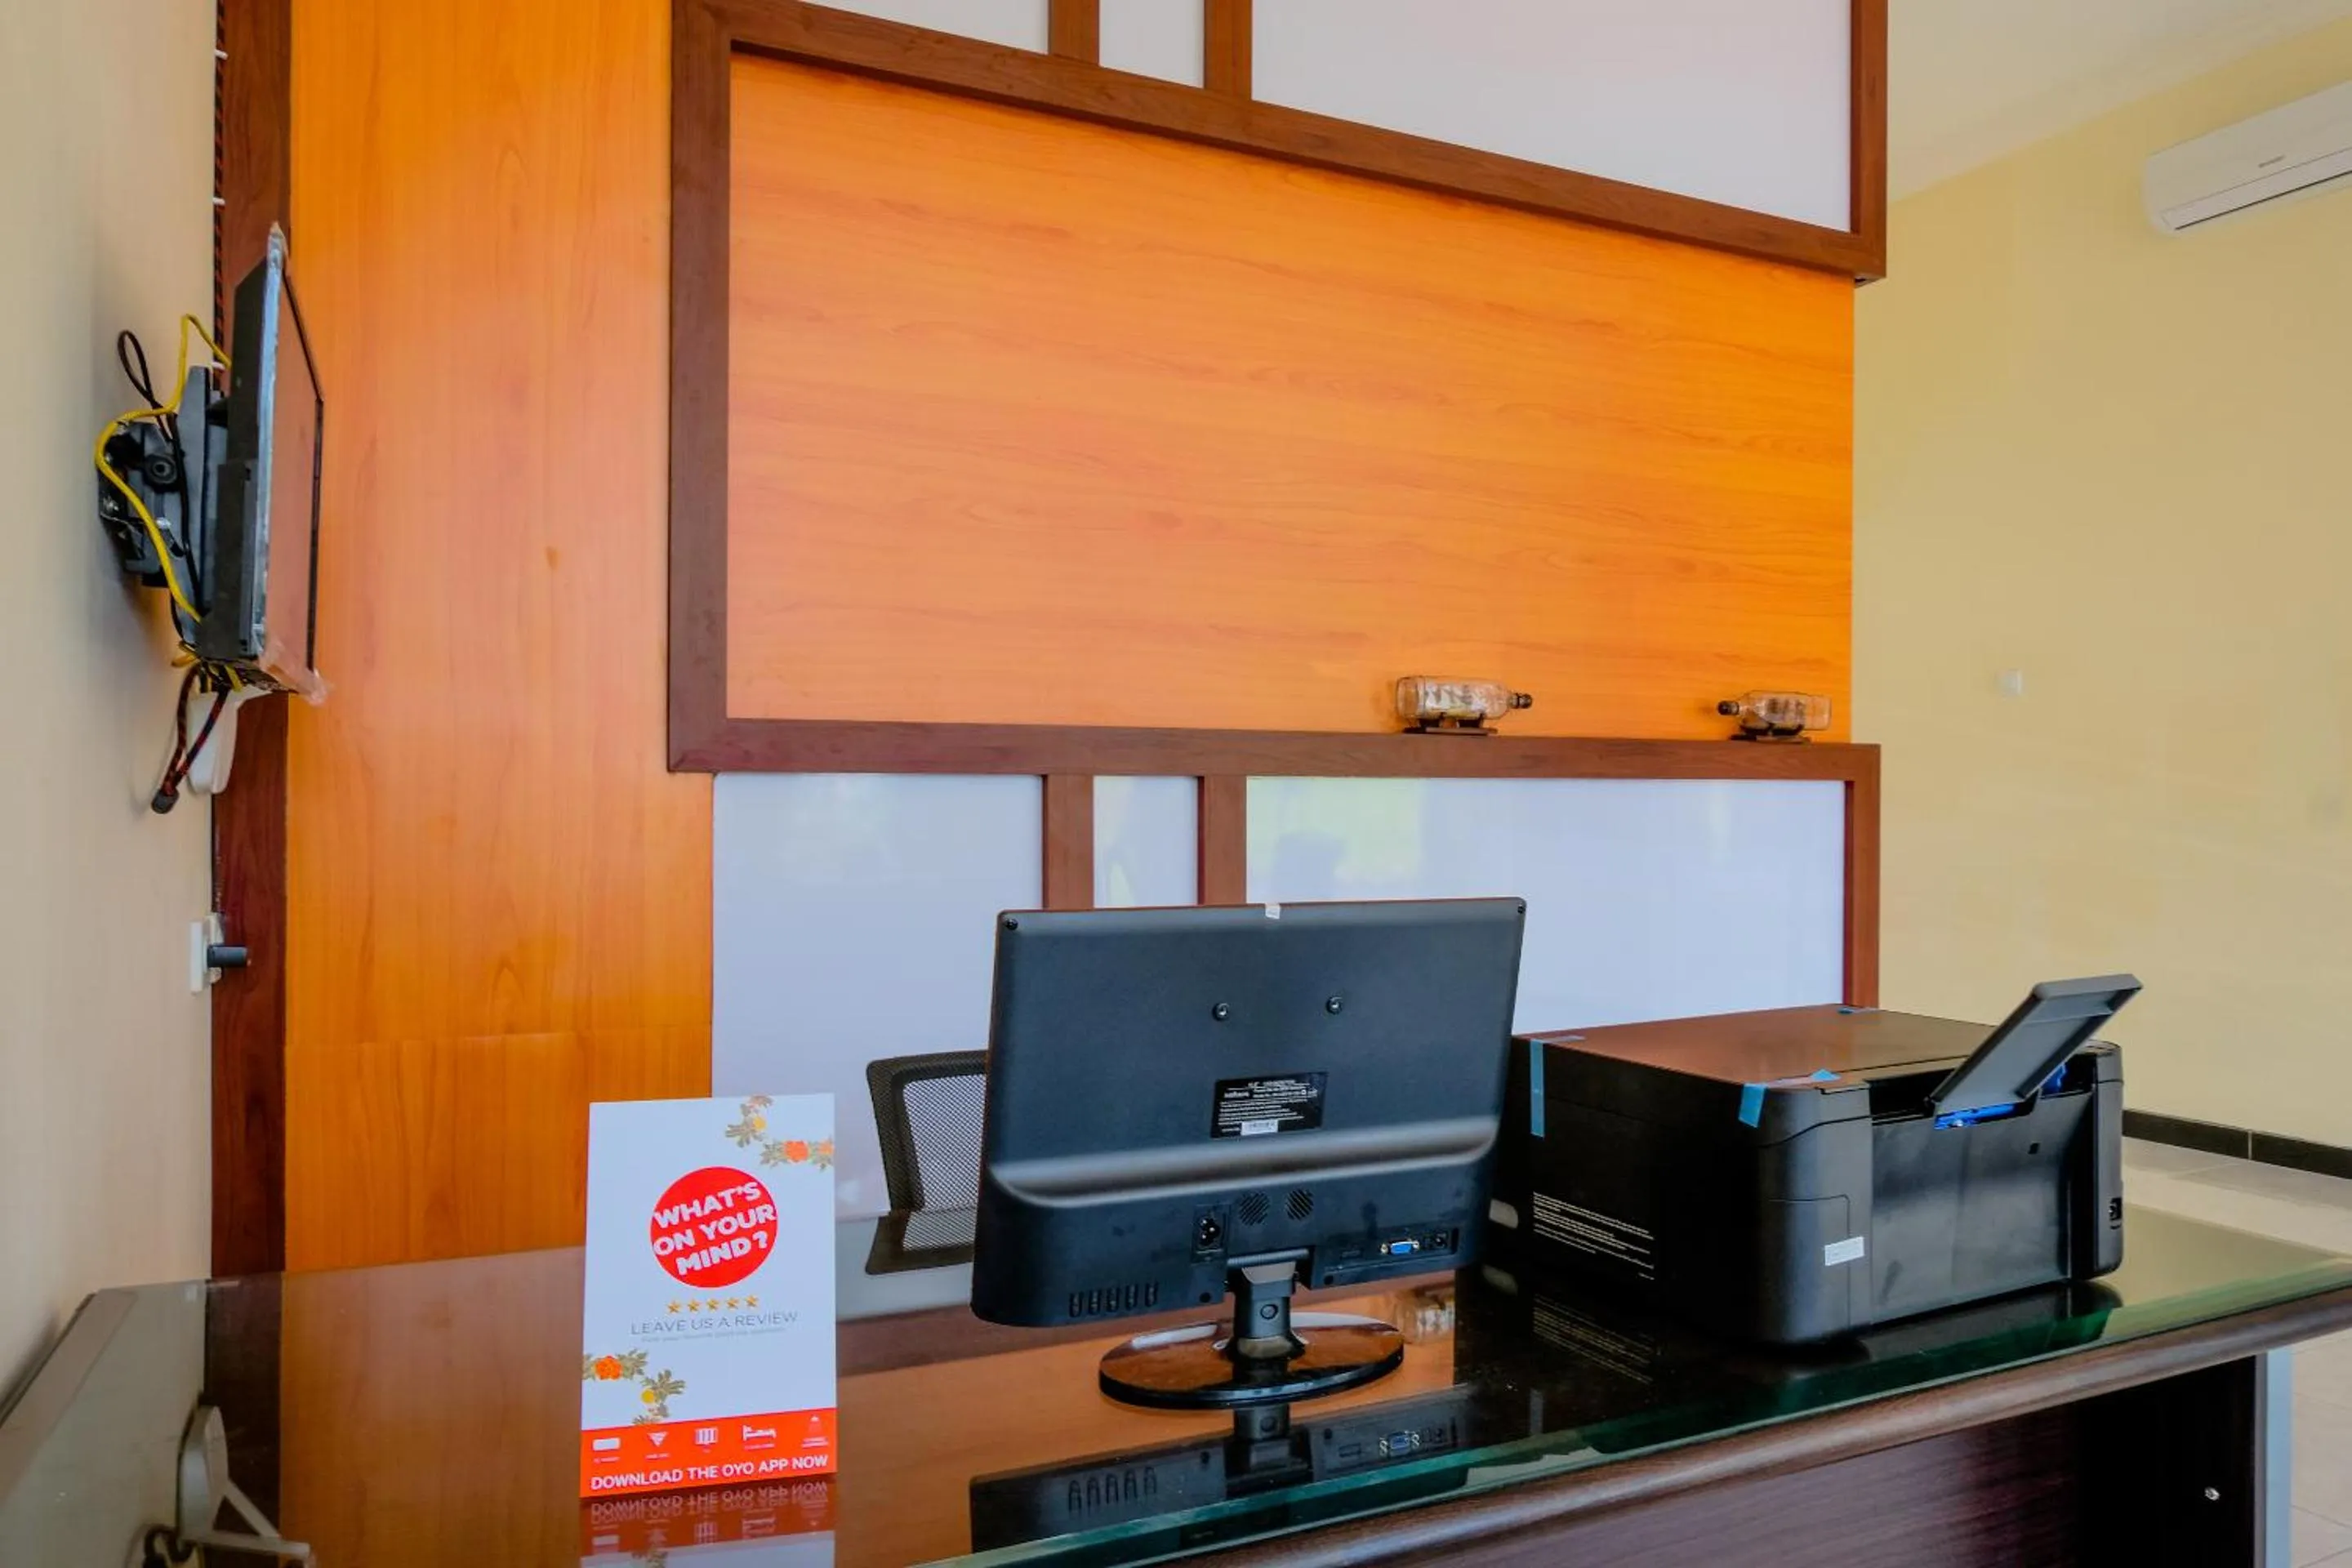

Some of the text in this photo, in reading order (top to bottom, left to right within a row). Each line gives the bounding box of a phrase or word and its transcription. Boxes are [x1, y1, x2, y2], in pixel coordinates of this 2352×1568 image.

[653, 1182, 761, 1228] WHAT'S
[653, 1204, 776, 1255] ON YOUR
[631, 1320, 687, 1335] LEAVE
[691, 1317, 714, 1330] US
[718, 1316, 731, 1328] A
[735, 1311, 798, 1327] REVIEW
[590, 1455, 829, 1490] DOWNLOAD THE OYO APP NOW
